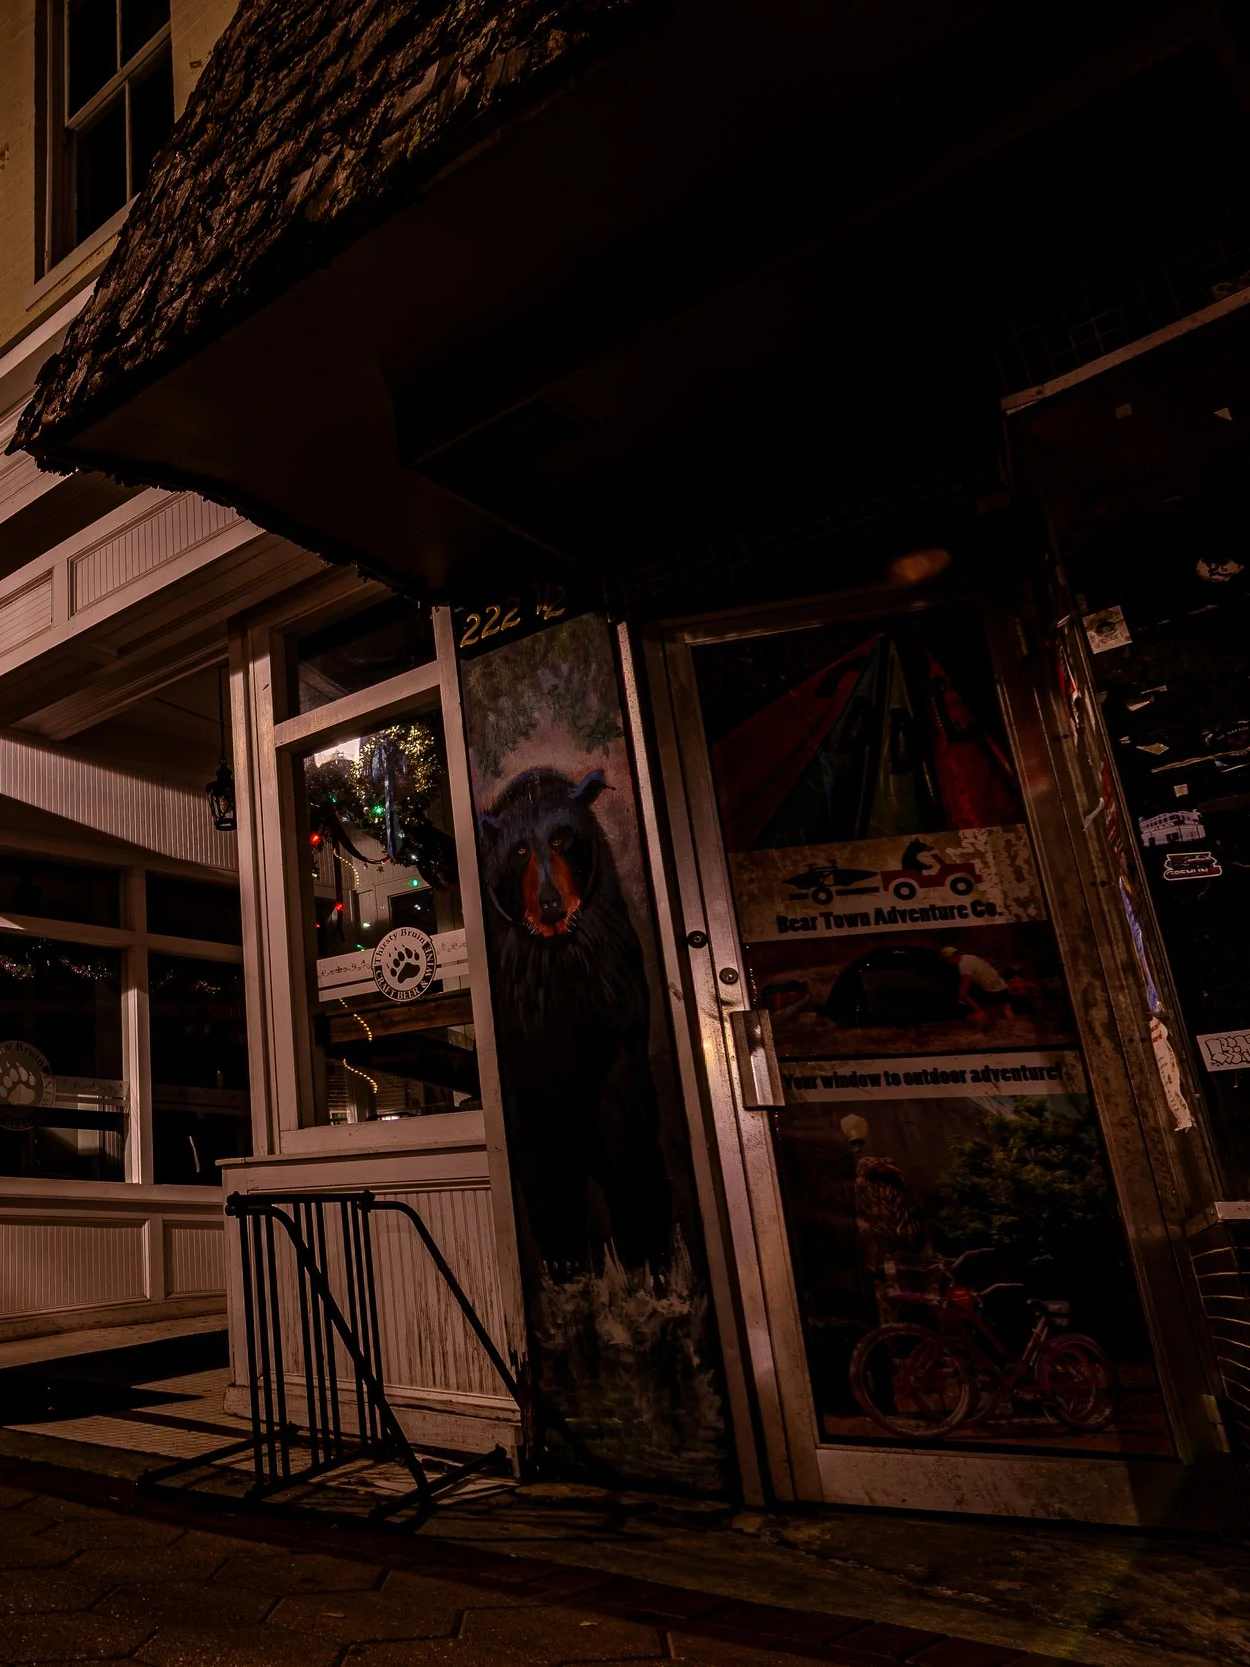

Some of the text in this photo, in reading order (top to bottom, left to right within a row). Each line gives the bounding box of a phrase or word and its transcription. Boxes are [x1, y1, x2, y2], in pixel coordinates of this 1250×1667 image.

[459, 596, 521, 648] 222
[776, 898, 1004, 934] Bear Town Adventure Co.
[374, 928, 425, 965] Thirsty Bruin
[375, 969, 397, 997] CRAFT
[397, 987, 421, 1000] BEER
[425, 945, 434, 977] WINE
[783, 1074, 818, 1090] Your
[819, 1070, 881, 1089] window
[883, 1070, 901, 1086] to
[903, 1067, 966, 1085] outdoor
